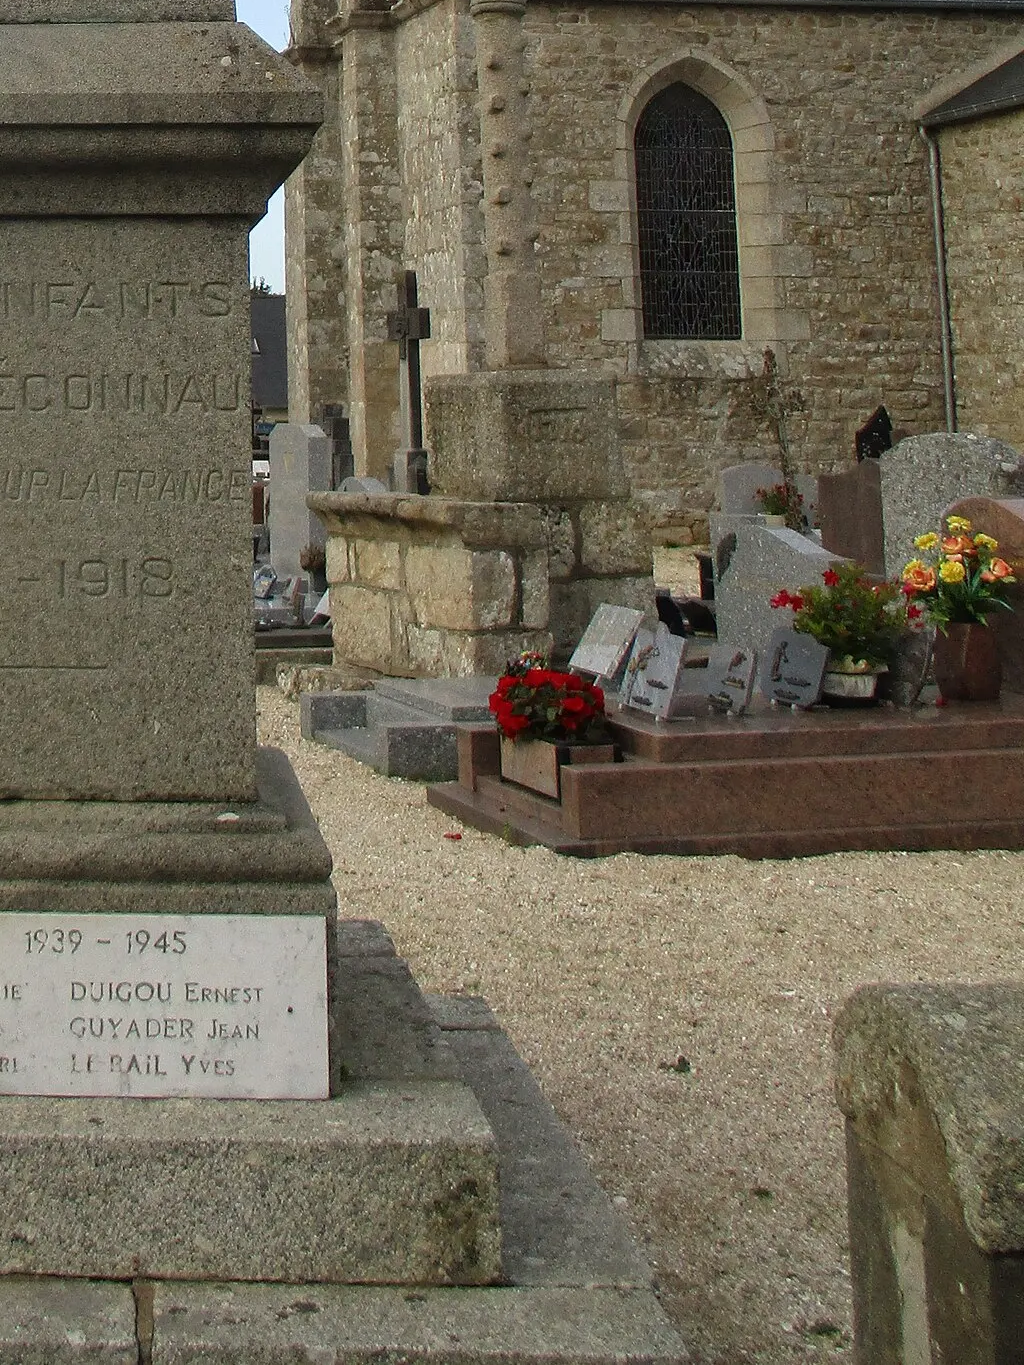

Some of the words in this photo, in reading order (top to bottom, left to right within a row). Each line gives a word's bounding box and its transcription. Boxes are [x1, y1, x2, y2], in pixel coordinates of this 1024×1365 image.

[58, 469, 102, 501] LA
[112, 469, 247, 503] FRANCE
[25, 928, 83, 954] 1939
[126, 929, 187, 954] 1945
[71, 982, 171, 1003] DUIGOU
[185, 982, 264, 1004] ERNEST
[69, 1016, 194, 1039] GUYADER
[207, 1018, 260, 1040] JEAN
